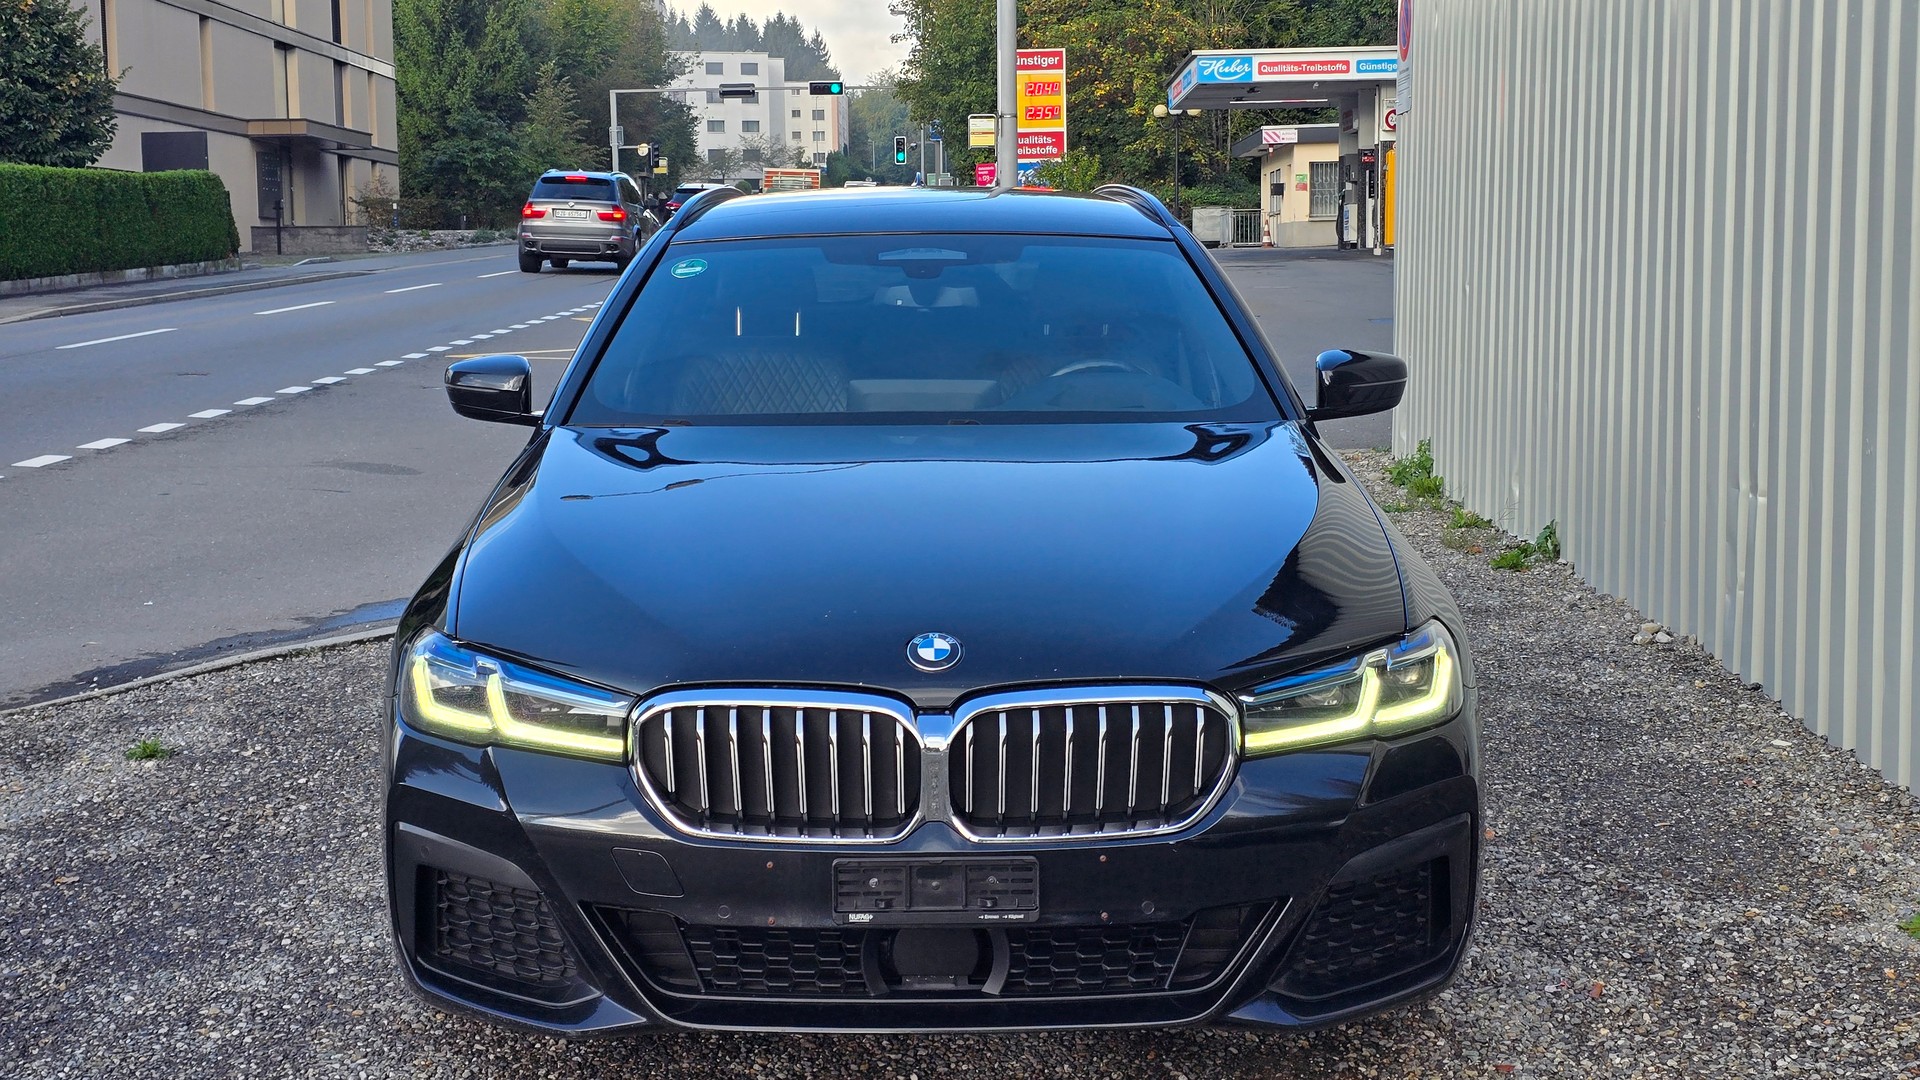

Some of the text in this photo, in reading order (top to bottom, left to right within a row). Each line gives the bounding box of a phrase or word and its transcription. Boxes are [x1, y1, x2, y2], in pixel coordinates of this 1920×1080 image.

[1016, 55, 1060, 67] ünstiger
[1199, 59, 1251, 80] Huber
[1260, 62, 1347, 73] Qualitäts-Treibstoffe
[1359, 62, 1397, 72] Günstige
[1018, 135, 1056, 144] ualitäts-
[1017, 146, 1058, 154] eibstoffe
[913, 633, 956, 644] BMW
